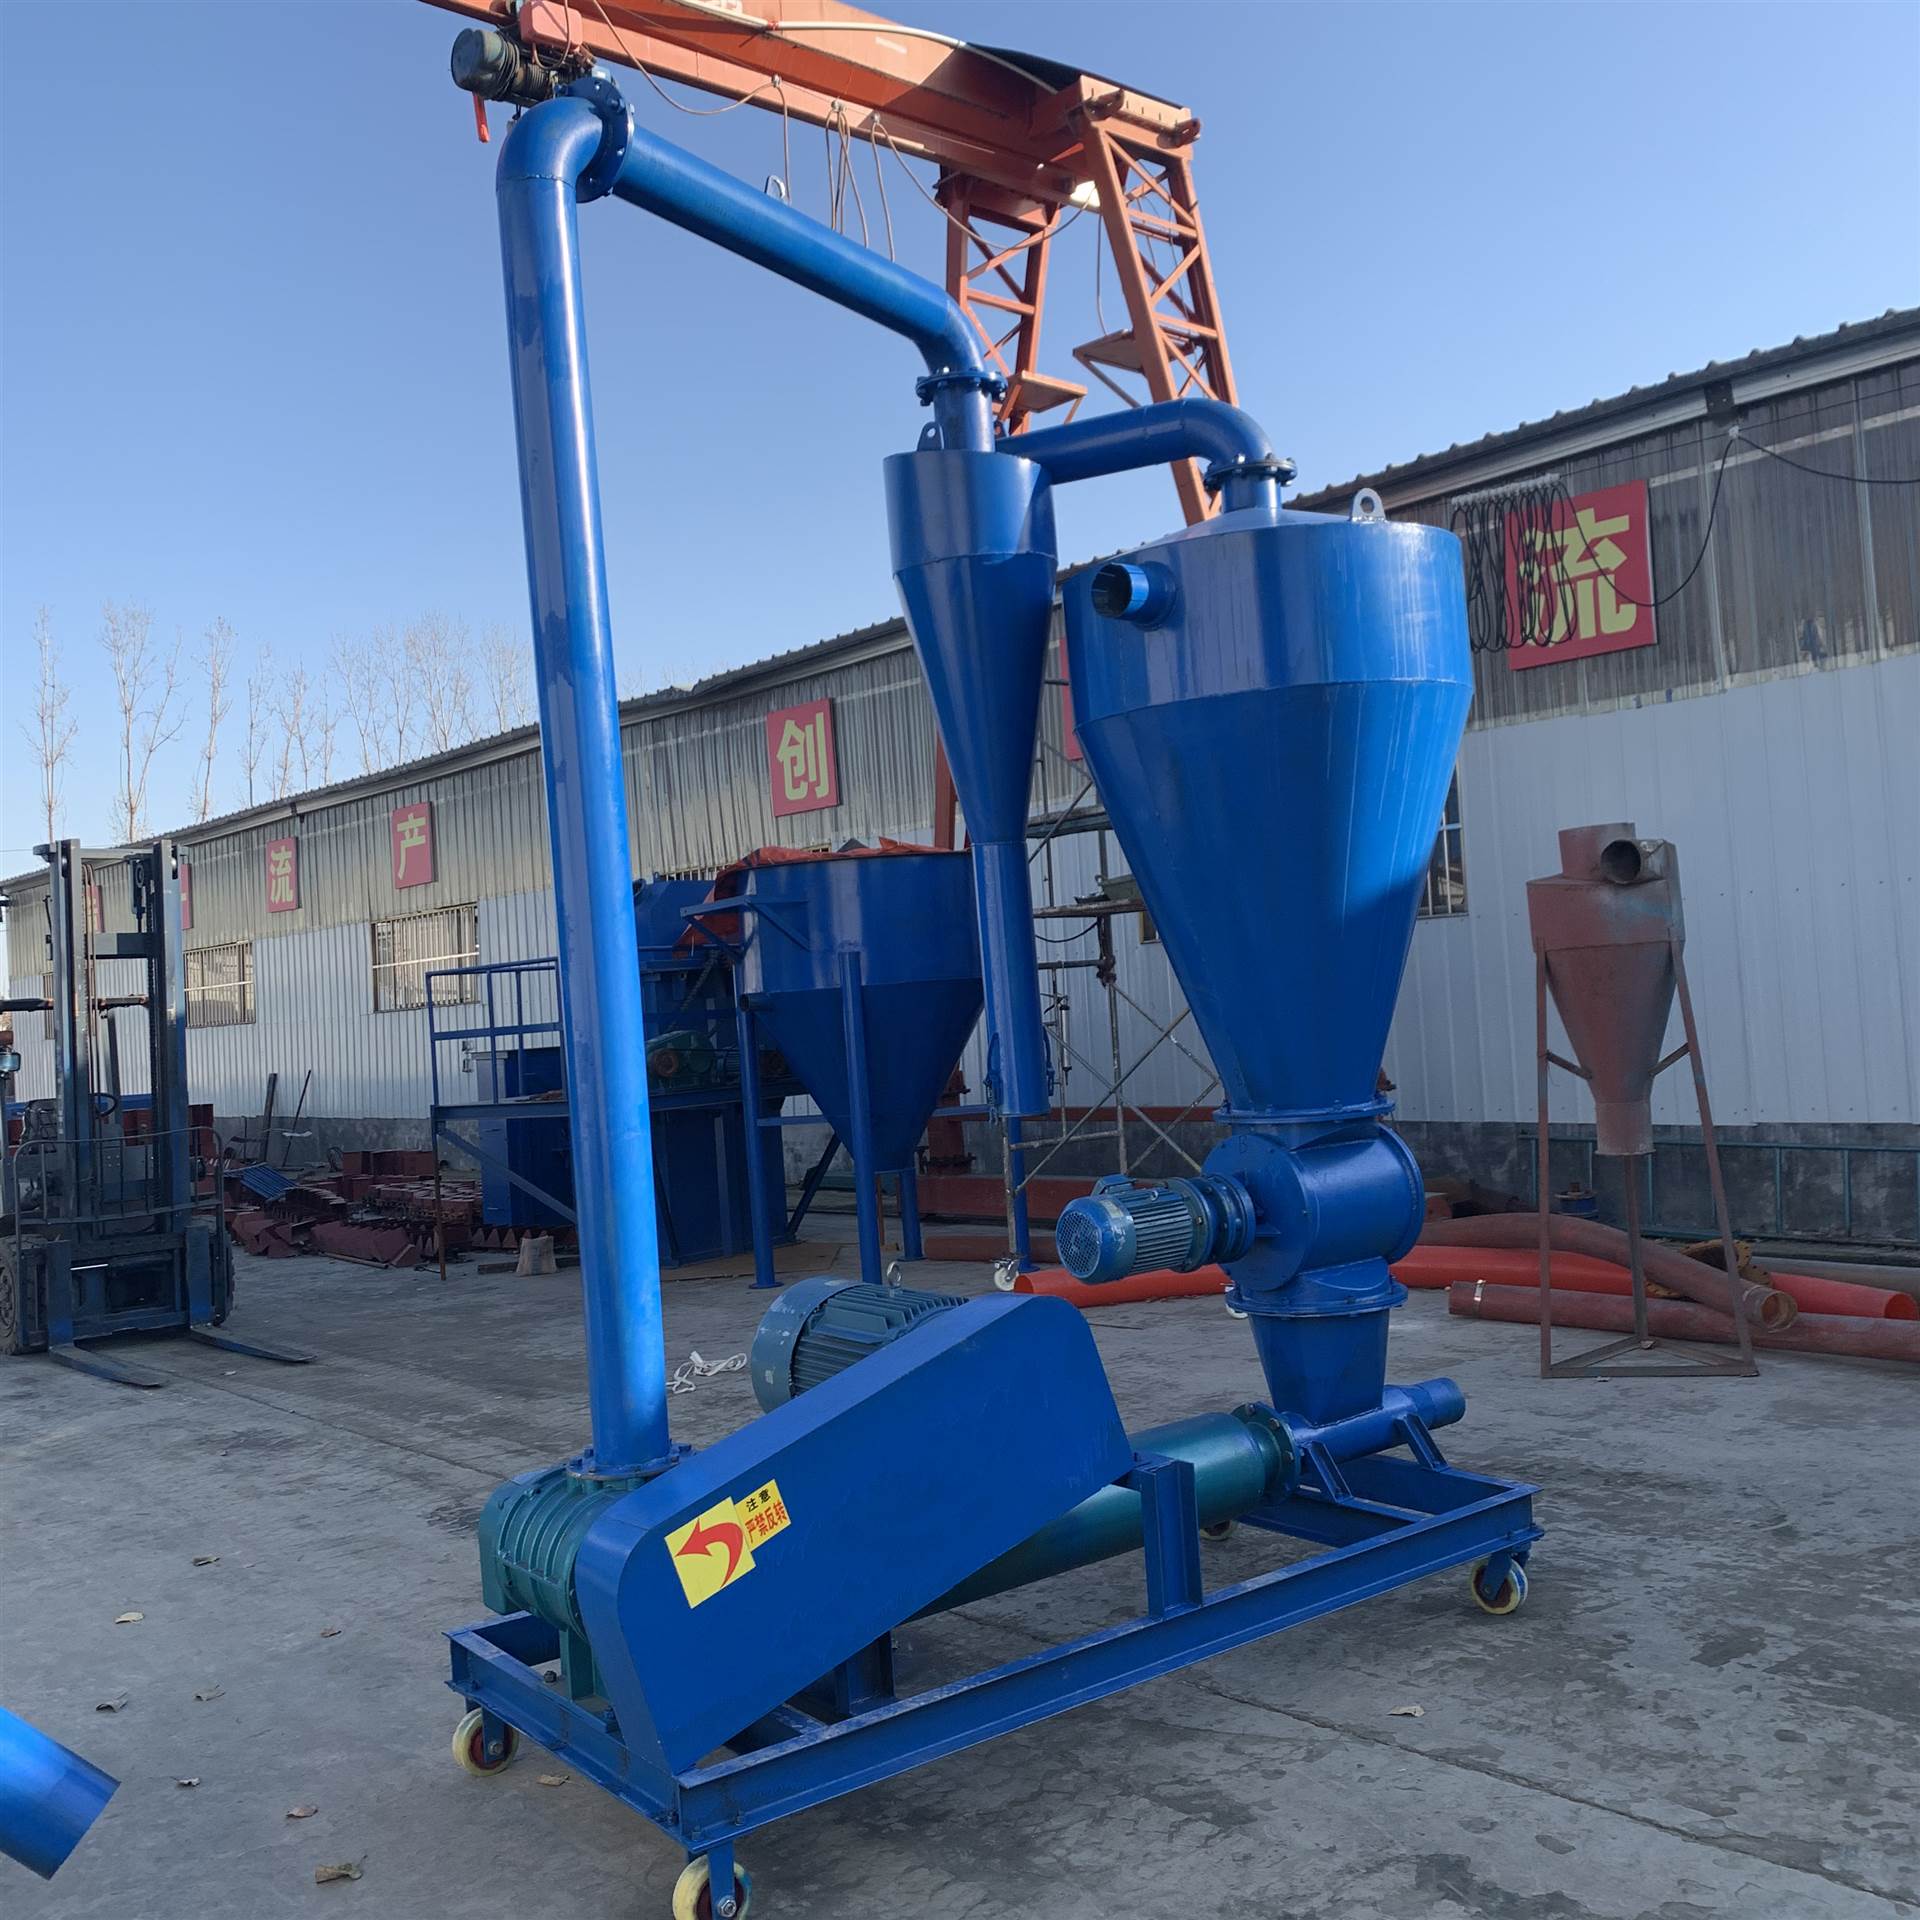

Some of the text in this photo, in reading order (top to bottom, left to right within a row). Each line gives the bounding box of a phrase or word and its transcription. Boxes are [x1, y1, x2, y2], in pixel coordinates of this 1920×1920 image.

[1519, 507, 1637, 648] 流
[776, 711, 830, 802] 创
[270, 845, 294, 904] 流
[397, 812, 426, 880] 产
[745, 1499, 787, 1544] 严禁反转
[746, 1488, 771, 1513] 注意
